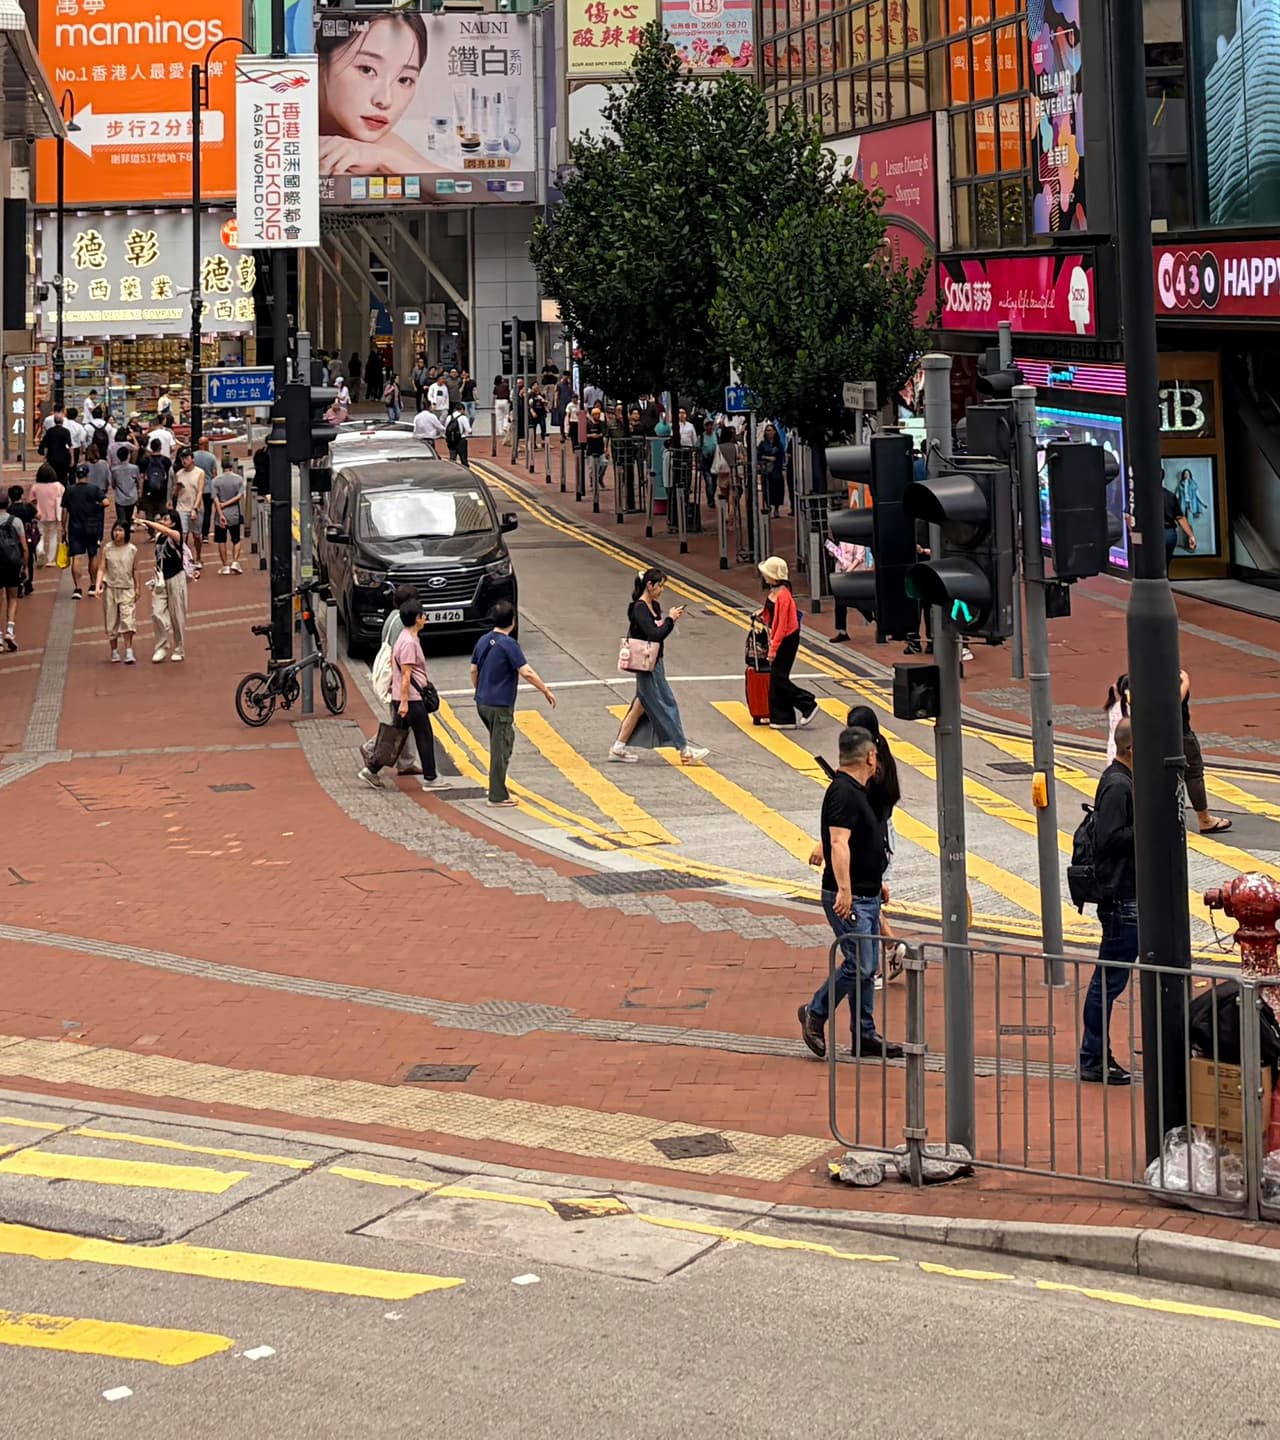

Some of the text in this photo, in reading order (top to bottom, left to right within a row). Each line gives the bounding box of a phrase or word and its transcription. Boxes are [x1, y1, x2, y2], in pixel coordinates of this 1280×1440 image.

[584, 0, 640, 25] 傷心
[55, 14, 224, 50] mannings
[460, 21, 508, 34] NAUNI
[448, 45, 508, 77] 鑽白
[55, 67, 88, 82] No.1
[1039, 69, 1072, 94] ISLAND
[1034, 93, 1080, 118] BEVERLEY
[253, 104, 264, 240] ASIA'S WORLD CITY
[265, 103, 281, 241] HONG KONG
[282, 102, 301, 240] 香港亞洲國際都會
[904, 155, 923, 176] Dining
[895, 184, 921, 206] Shopping
[71, 229, 161, 270] 德彰
[200, 253, 257, 295] 德彰
[974, 280, 992, 312] 莎莎
[222, 376, 265, 385] Taxi Stand
[226, 388, 260, 399] 的士站
